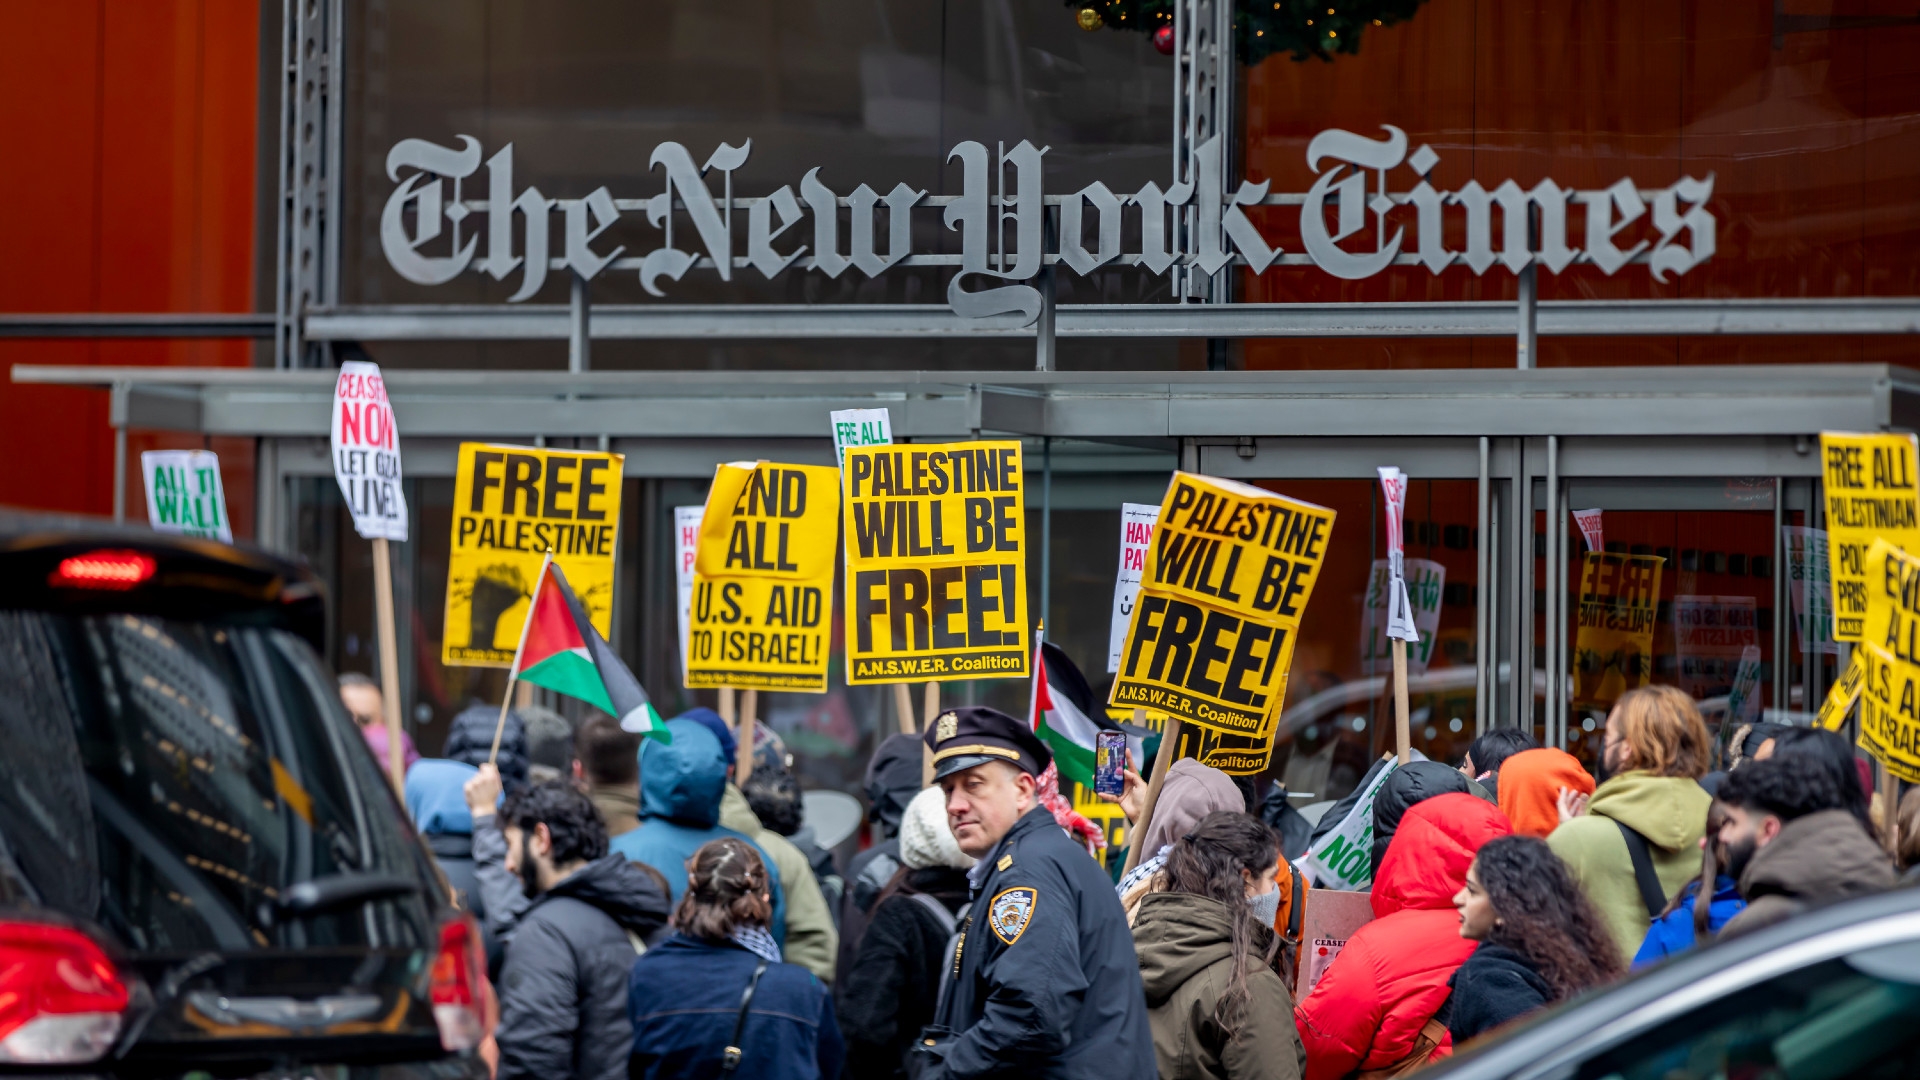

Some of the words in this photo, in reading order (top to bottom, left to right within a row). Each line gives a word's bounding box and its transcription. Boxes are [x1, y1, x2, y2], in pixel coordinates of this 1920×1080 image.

[380, 134, 626, 303] The
[639, 137, 929, 296] New
[944, 133, 1283, 328] York
[1300, 123, 1717, 284] Times
[862, 421, 888, 444] ALL
[340, 449, 369, 475] LET
[471, 452, 609, 520] FREE
[851, 448, 1019, 497] PALESTINE
[1873, 446, 1913, 489] ALL
[459, 516, 614, 557] PALESTINE
[853, 500, 954, 559] WILL
[965, 496, 1019, 553] BE
[1164, 482, 1328, 559] PALESTINE
[725, 521, 798, 571] ALL
[1154, 528, 1243, 604] WILL
[1252, 557, 1313, 616] BE
[697, 582, 752, 625] U.S.
[765, 586, 821, 628] AID
[856, 564, 1020, 653] FREE!
[693, 630, 712, 661] TO
[721, 630, 820, 665] ISRAEL!
[857, 658, 949, 677] A.N.S.W.E.R.
[951, 656, 1020, 671] Coalition
[1124, 596, 1288, 707] FREE!
[1118, 686, 1193, 714] A.N.S.W.E.R.
[1197, 703, 1258, 729] Coalition
